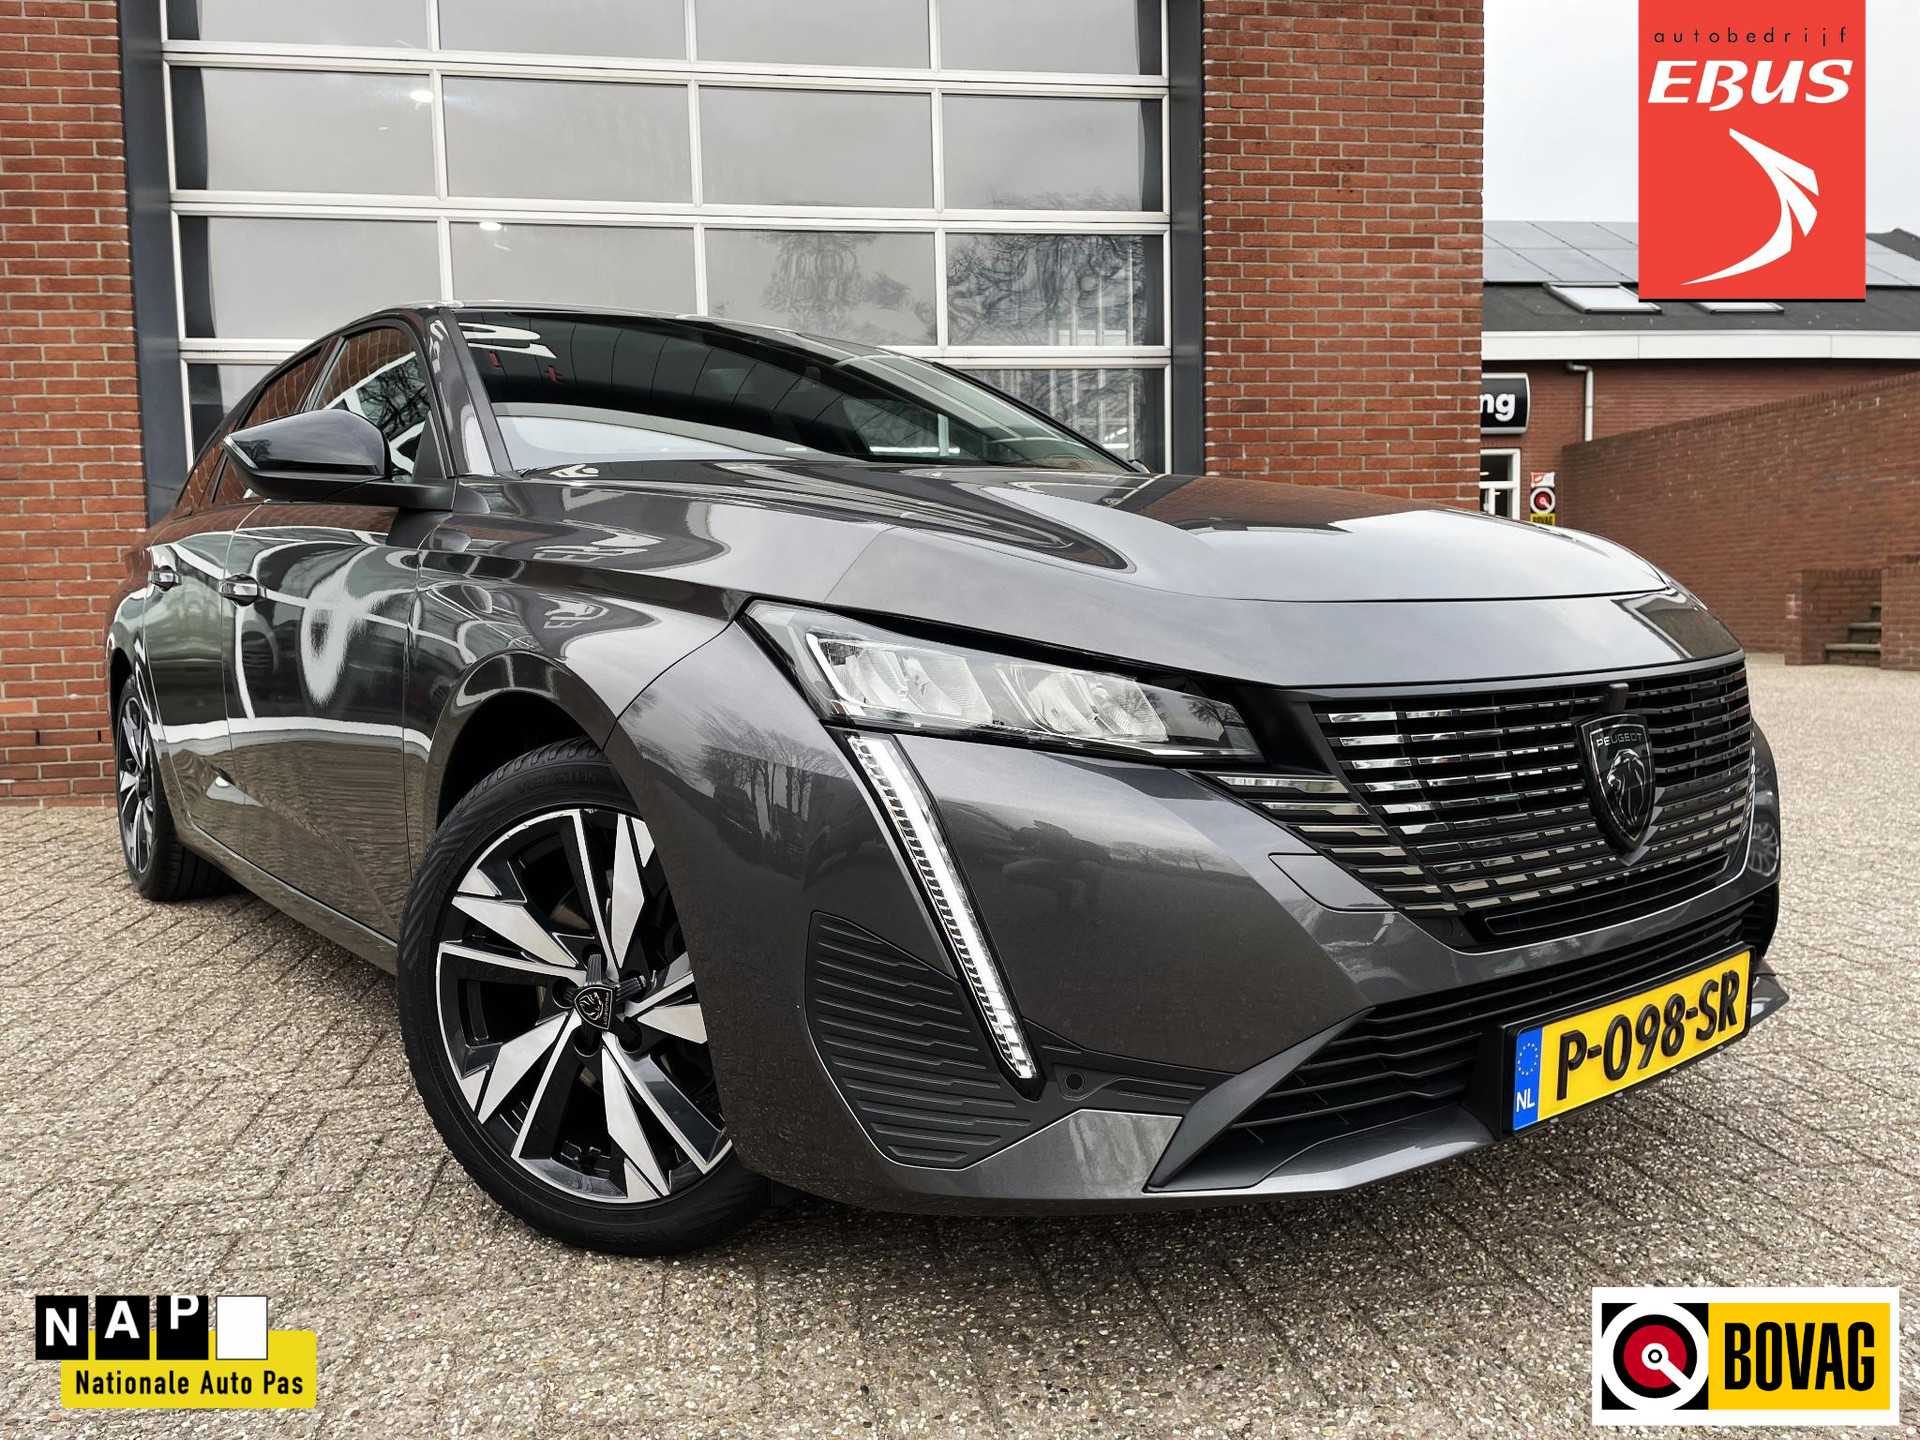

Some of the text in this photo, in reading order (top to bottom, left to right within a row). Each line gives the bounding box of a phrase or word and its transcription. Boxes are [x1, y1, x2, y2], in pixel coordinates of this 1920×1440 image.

[1596, 732, 1642, 747] PEUGEOT
[1557, 970, 1739, 1101] P-098-SR
[1516, 1088, 1535, 1112] NL
